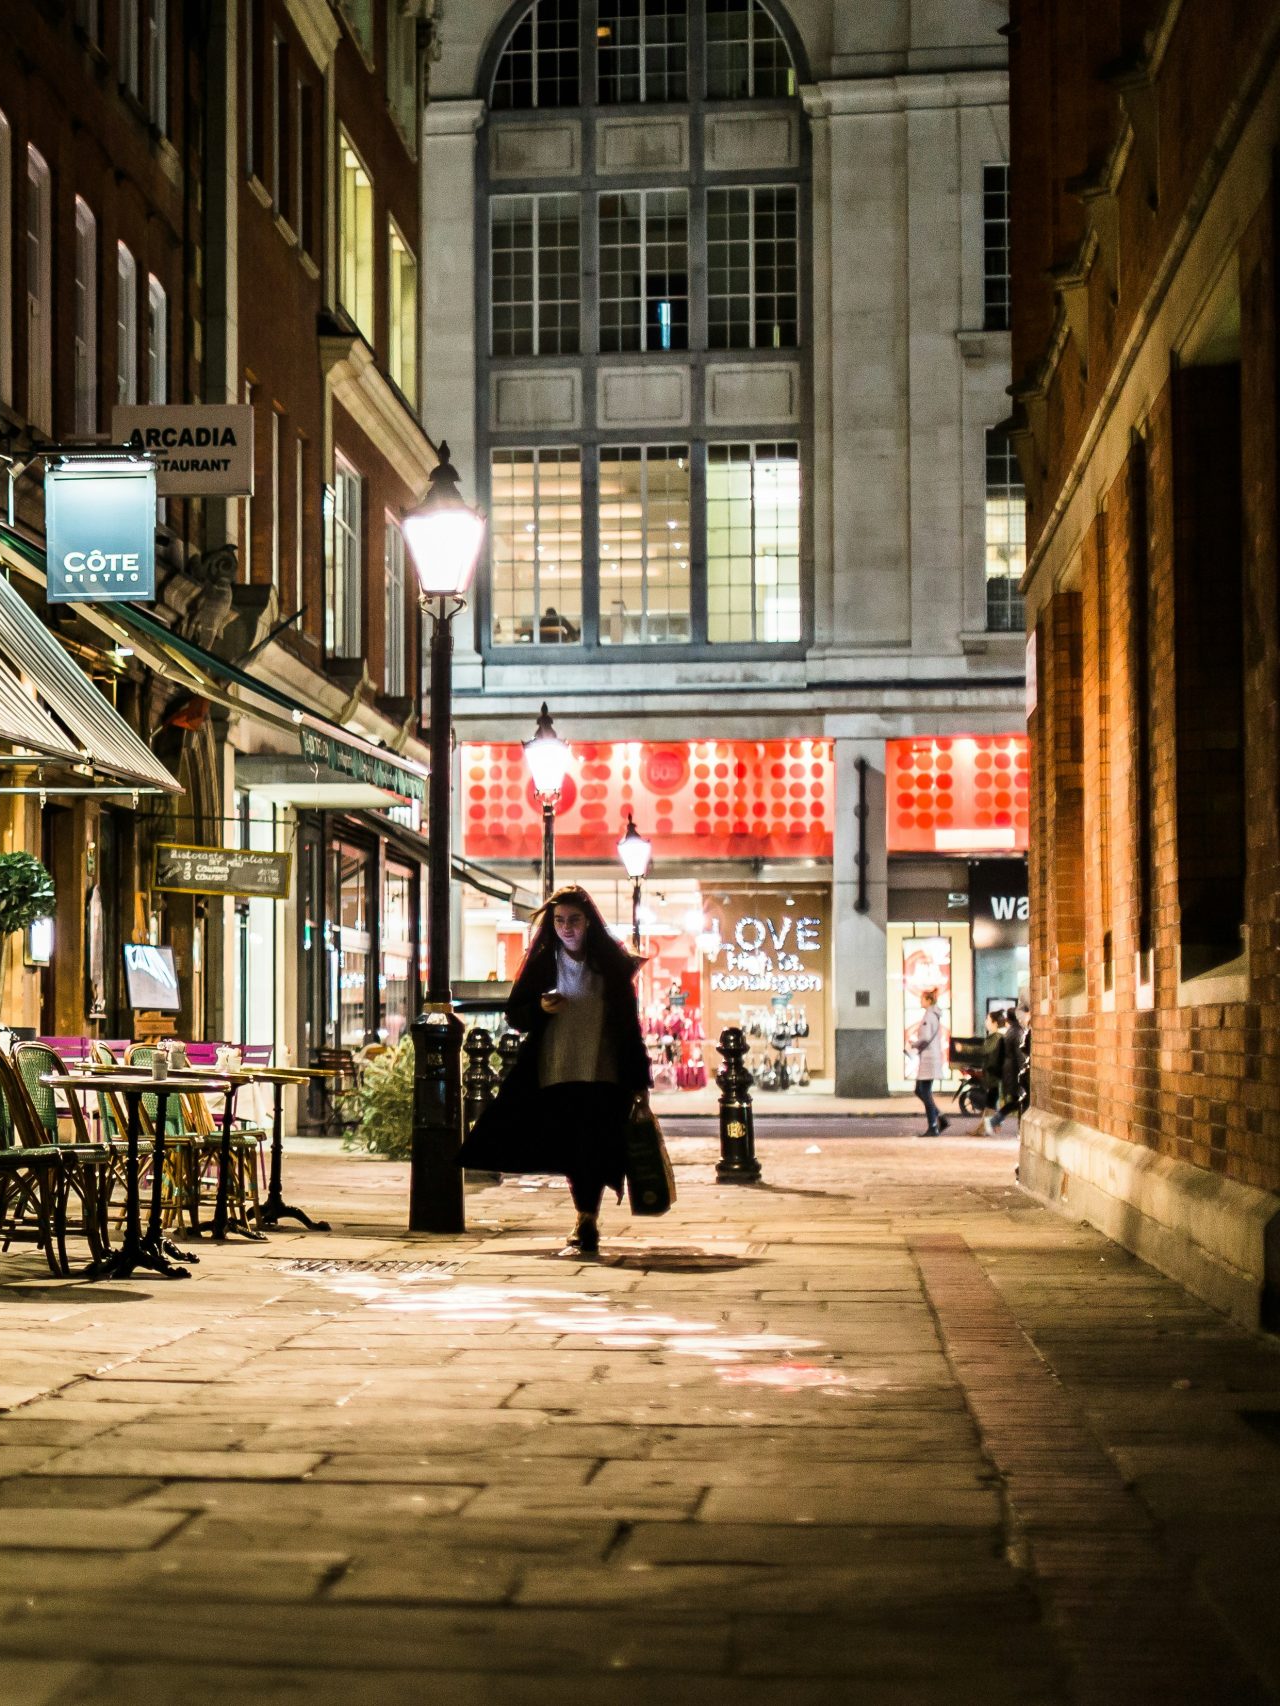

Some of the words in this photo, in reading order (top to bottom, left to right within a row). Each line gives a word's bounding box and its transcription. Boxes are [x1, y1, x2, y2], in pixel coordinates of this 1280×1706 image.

[130, 428, 237, 449] ARCADIA
[63, 549, 139, 572] CÔTE
[64, 573, 138, 583] BISTRO
[184, 861, 192, 871] 2
[183, 871, 191, 880] 3
[711, 916, 821, 951] LOVE
